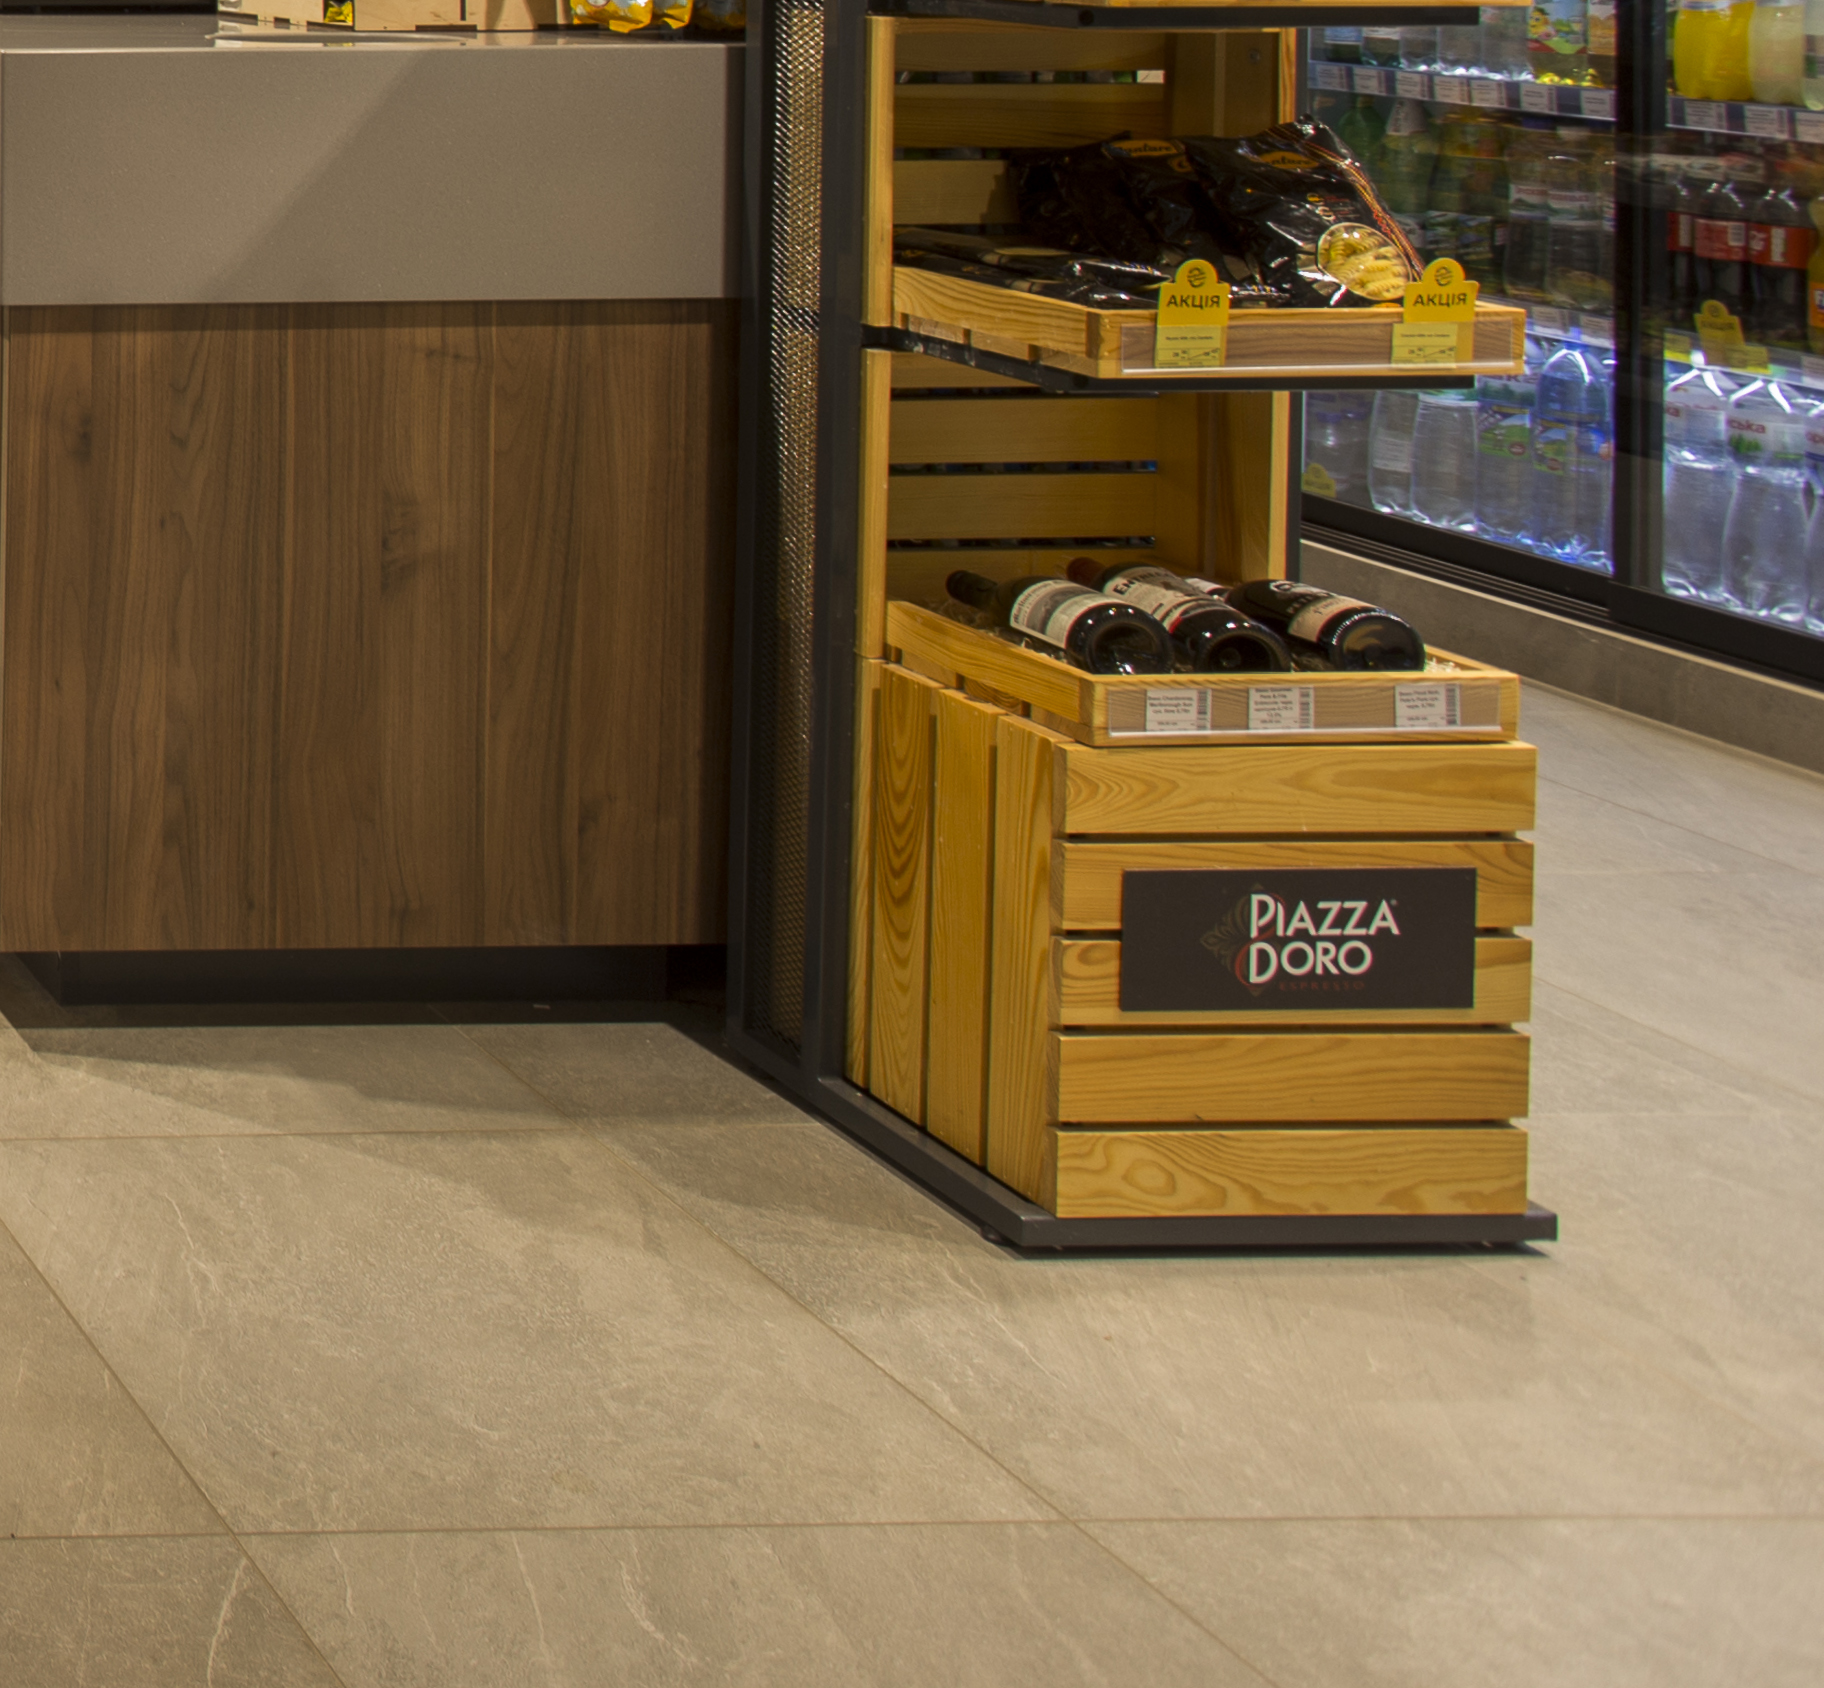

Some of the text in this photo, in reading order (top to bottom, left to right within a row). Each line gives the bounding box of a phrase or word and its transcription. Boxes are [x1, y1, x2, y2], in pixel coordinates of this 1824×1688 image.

[1166, 295, 1221, 310] АКЦІЯ
[1412, 293, 1468, 308] АКЦІЯ
[1251, 893, 1401, 939] PIAZZA
[1249, 941, 1373, 984] DORO
